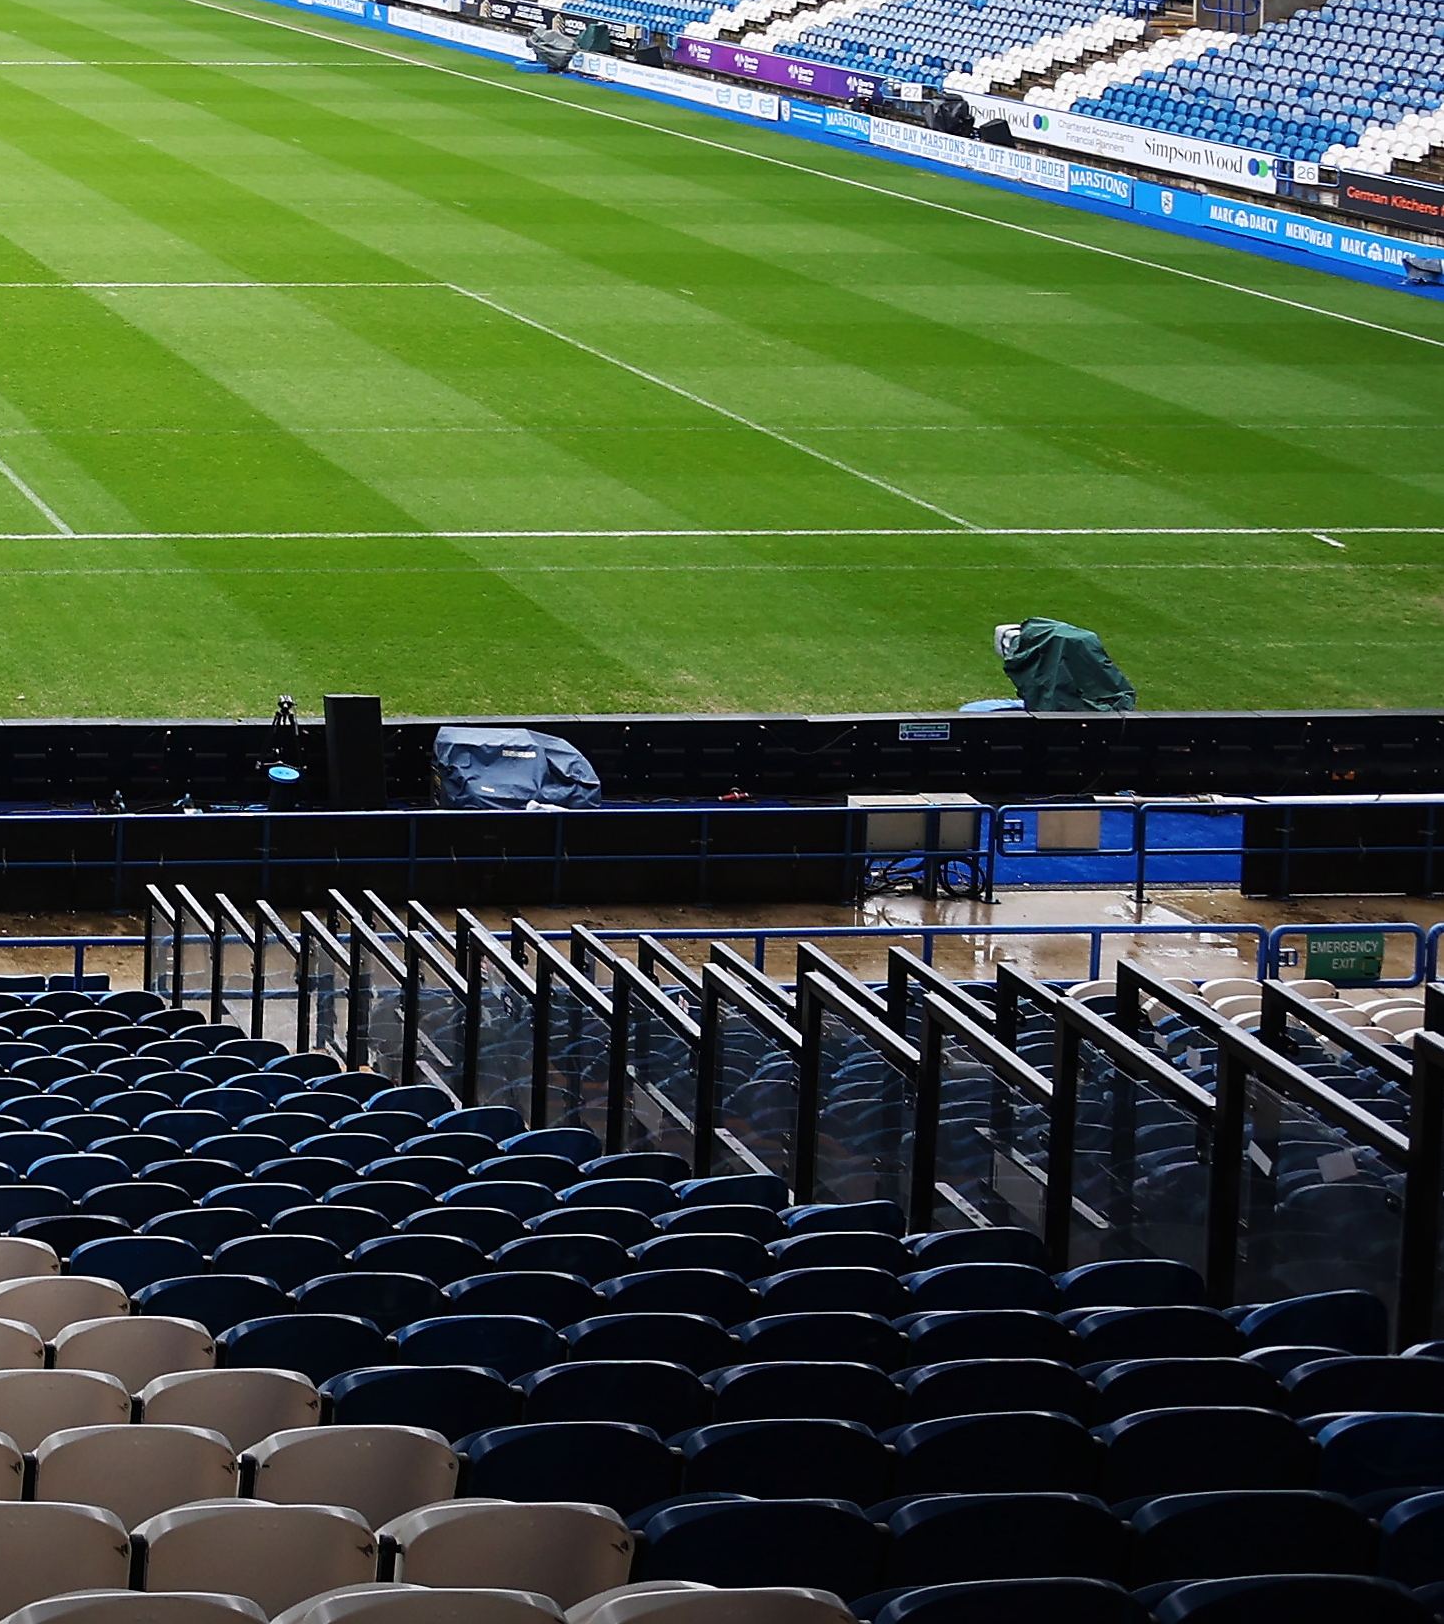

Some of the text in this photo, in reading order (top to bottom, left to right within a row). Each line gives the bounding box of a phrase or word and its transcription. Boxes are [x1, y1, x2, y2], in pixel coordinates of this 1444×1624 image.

[904, 86, 920, 99] 27
[969, 106, 1029, 128] pson Wood
[1058, 119, 1134, 143] Chartered Accountants
[873, 120, 1065, 178] MATCH DAY MARSTONS 20% OFF YOUR ORDER
[1066, 132, 1125, 154] Financial Planners
[1144, 137, 1243, 174] Simpson Wood
[1297, 165, 1316, 180] 26
[1347, 185, 1439, 216] German Kitchens
[1210, 205, 1234, 224] MARC
[1250, 215, 1278, 233] DARCY
[1285, 222, 1334, 248] MENSWEAR
[1340, 237, 1366, 257] MARC
[1310, 940, 1380, 954] EMERGENCY
[1332, 957, 1356, 969] EXIT
